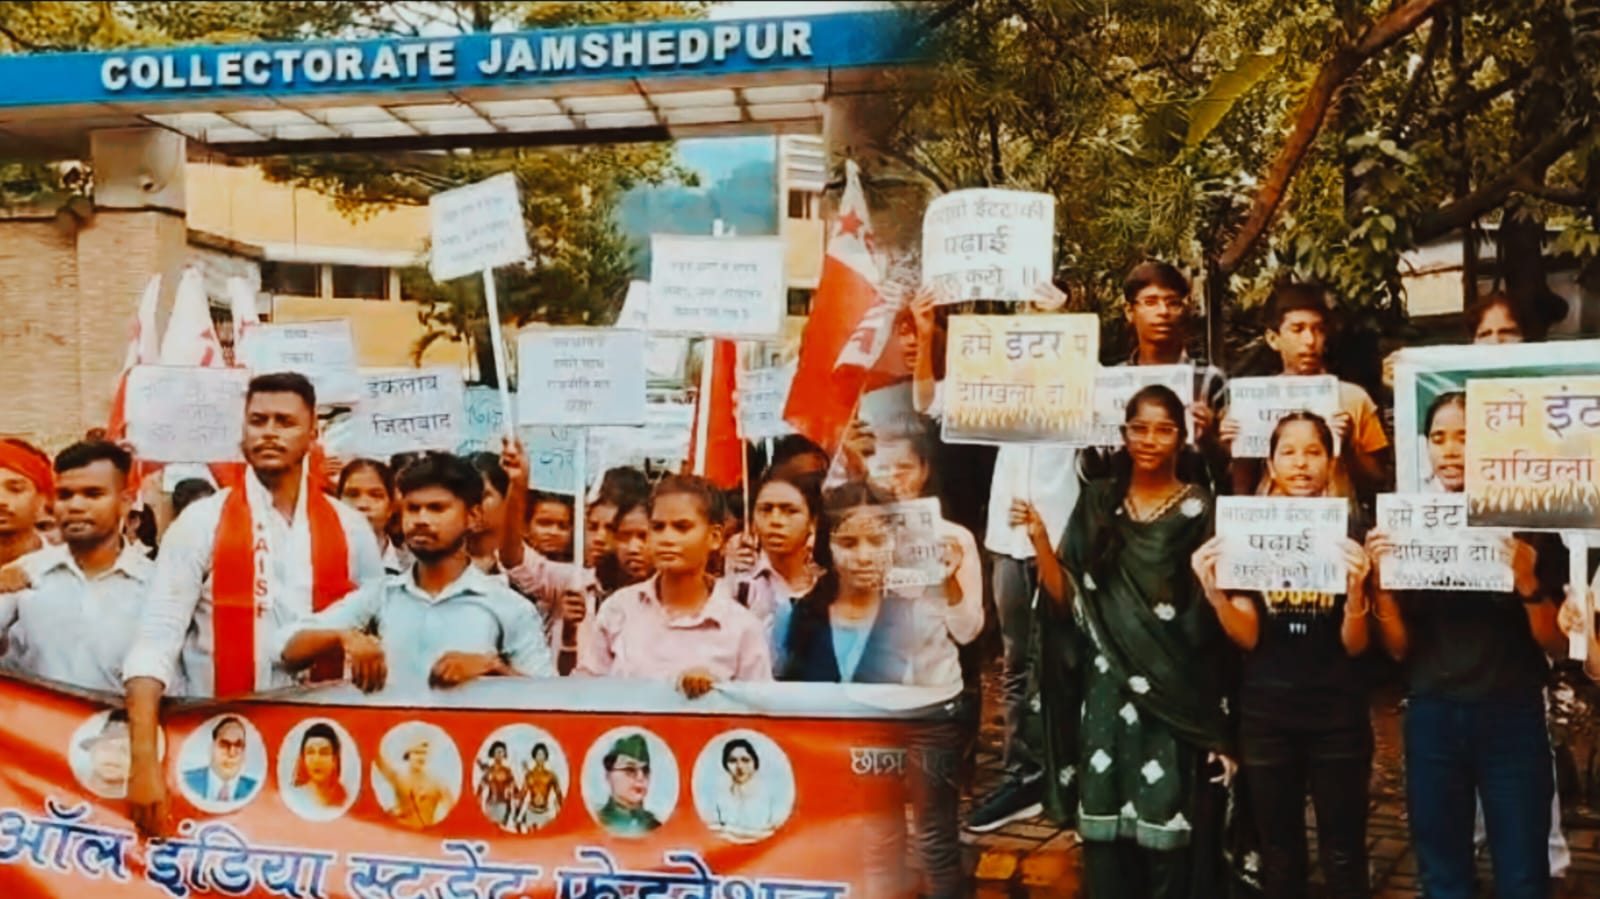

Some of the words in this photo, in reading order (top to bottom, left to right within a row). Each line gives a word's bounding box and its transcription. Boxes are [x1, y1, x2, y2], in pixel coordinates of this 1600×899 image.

[101, 42, 455, 93] COLLECTORATE
[478, 20, 813, 77] JAMSHEDPUR
[1543, 384, 1600, 439] इंट
[1479, 448, 1594, 484] दाखिला
[1422, 498, 1466, 529] इंट
[849, 745, 907, 776] छात्र
[0, 797, 135, 880] ऑल
[146, 820, 336, 899] इंडिया
